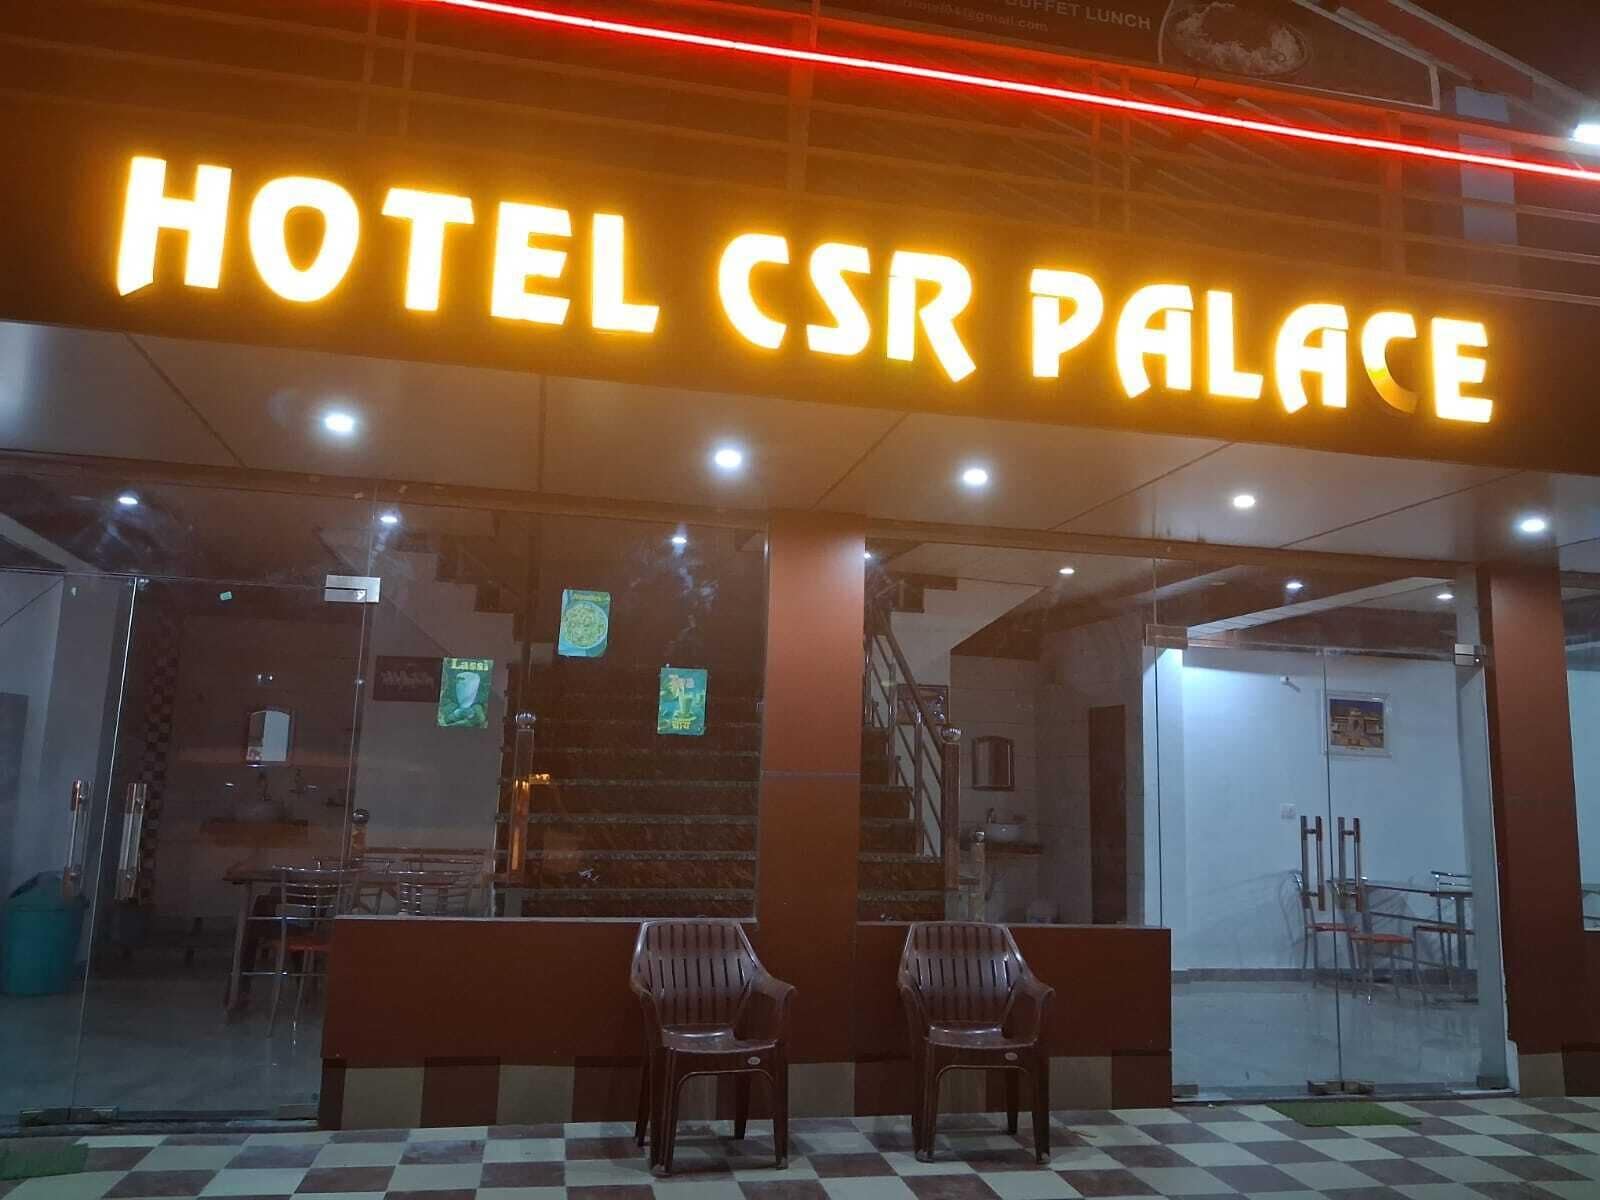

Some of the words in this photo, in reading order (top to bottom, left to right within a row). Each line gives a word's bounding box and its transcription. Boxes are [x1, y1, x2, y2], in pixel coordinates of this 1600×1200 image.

[1086, 5, 1151, 30] LUNCH
[116, 155, 660, 334] HOTEL
[716, 233, 977, 383] CSR
[1028, 267, 1495, 424] PALACE
[450, 657, 489, 671] Lassi
